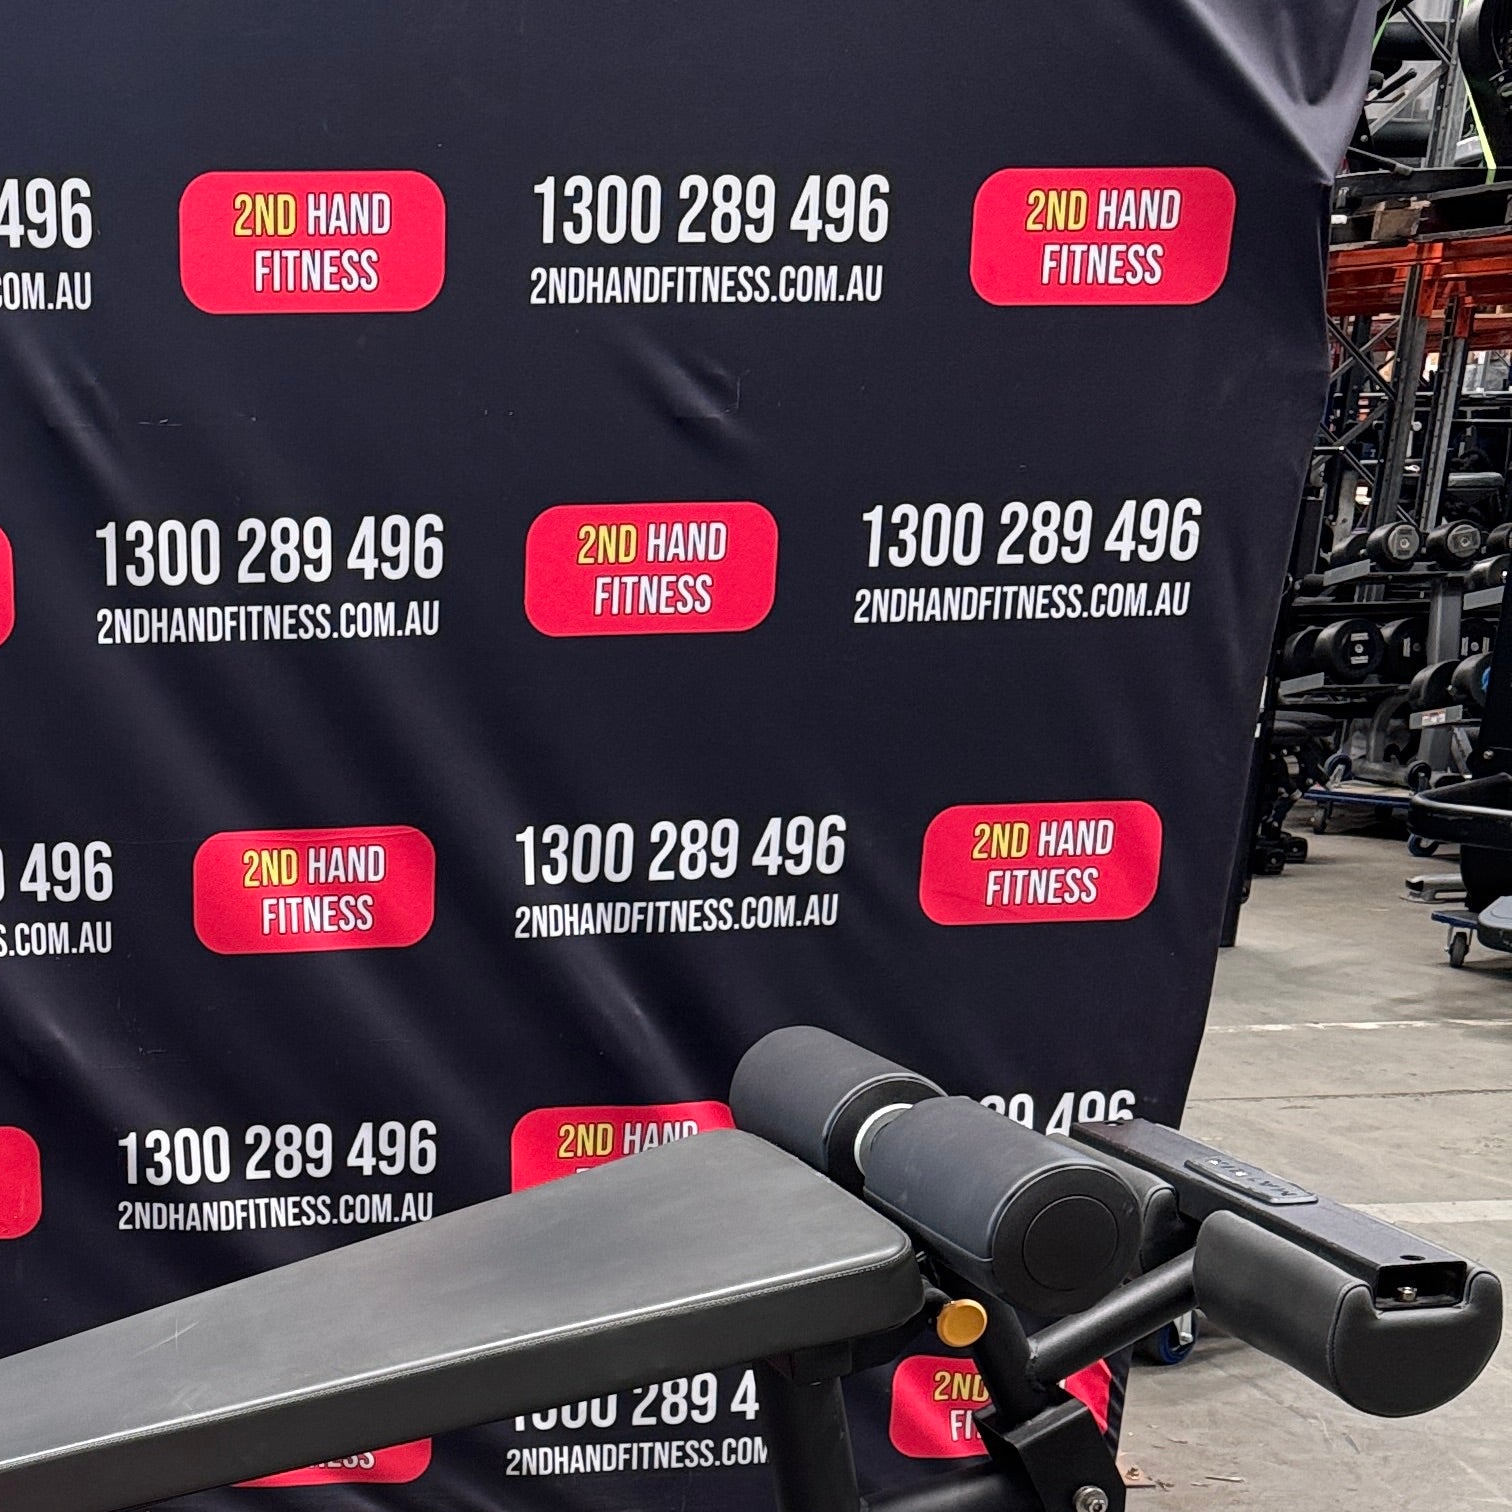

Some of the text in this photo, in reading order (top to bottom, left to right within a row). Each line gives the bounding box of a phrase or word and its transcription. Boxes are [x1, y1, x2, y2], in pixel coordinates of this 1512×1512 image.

[235, 194, 390, 235] 2ND HAND
[534, 174, 889, 244] 1300 289 496
[1027, 190, 1180, 230] 2ND HAND
[256, 250, 377, 291] FITNESS
[1043, 244, 1163, 284] FITNESS
[531, 265, 882, 304] 2NDHANDFITNESS.COM.AU
[96, 514, 443, 586] 1300 289 496
[579, 523, 726, 563] 2ND HAND
[863, 498, 1201, 567] 1300 289 496
[595, 575, 712, 614] FITNESS
[854, 582, 1190, 623] 2NDHANDFITNESS.COM.AU
[97, 601, 439, 644] 2NDHANDFITNESS.COM.AU
[516, 815, 846, 885] 1300 289 496
[973, 820, 1113, 858] 2ND HAND
[20, 841, 112, 901] 496
[244, 846, 384, 886] 2ND HAND
[987, 868, 1098, 905] FITNESS
[263, 895, 372, 934] FITNESS
[515, 894, 838, 938] 2NDHANDFITNESS.COM.AU
[119, 1120, 436, 1185] 1300 289 496
[559, 1124, 612, 1157] 2ND
[119, 1192, 433, 1231] 2NDHANDFITNESS.COM.AU
[507, 1437, 767, 1475] 2NDHANDFITNESS.COM
